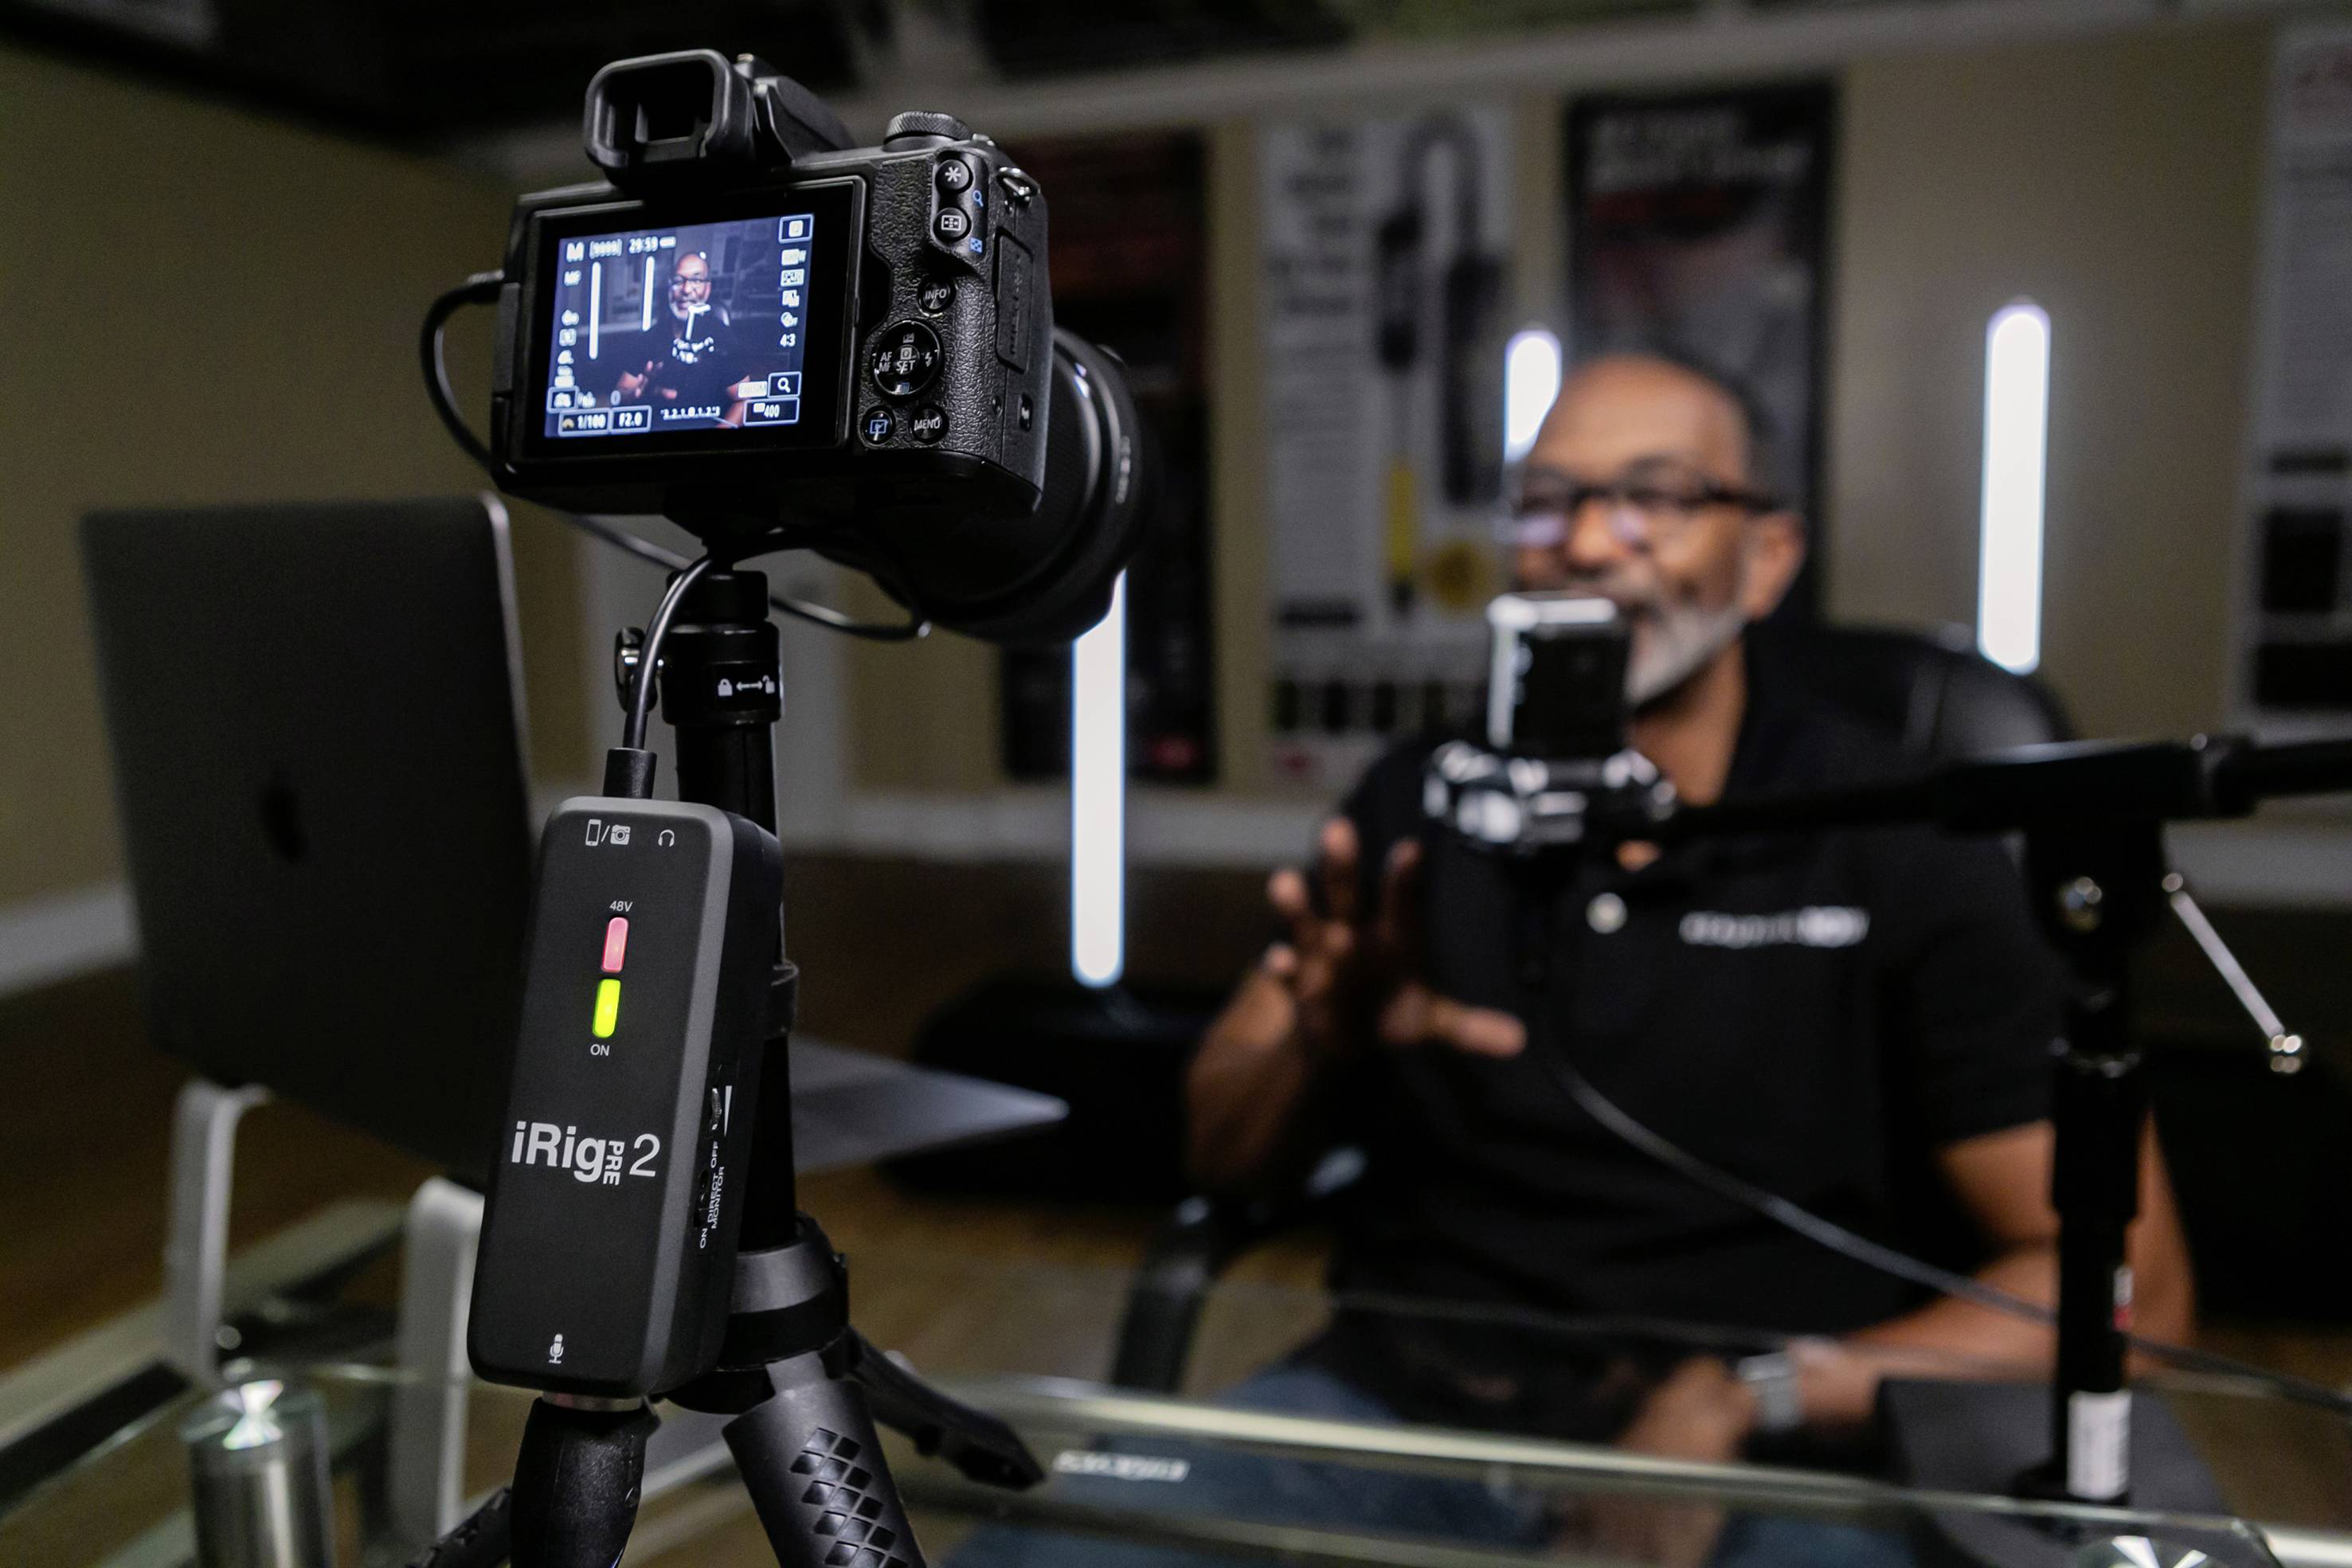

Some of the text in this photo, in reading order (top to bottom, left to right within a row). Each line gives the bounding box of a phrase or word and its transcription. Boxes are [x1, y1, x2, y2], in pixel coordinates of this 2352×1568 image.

[925, 288, 947, 300] INFO
[880, 351, 893, 362] AF
[879, 362, 891, 373] MF
[895, 361, 915, 373] SET
[577, 414, 606, 429] 1/100
[619, 412, 643, 427] F2.0
[764, 404, 780, 418] 400
[914, 419, 941, 431] MENU
[609, 900, 633, 913] 48V
[590, 1043, 610, 1057] ON
[511, 1120, 660, 1186] iRig PRE 2
[710, 1141, 718, 1168] OFF
[707, 1173, 718, 1223] DIRECT
[710, 1166, 725, 1230] MONITOR
[699, 1228, 708, 1249] ON
